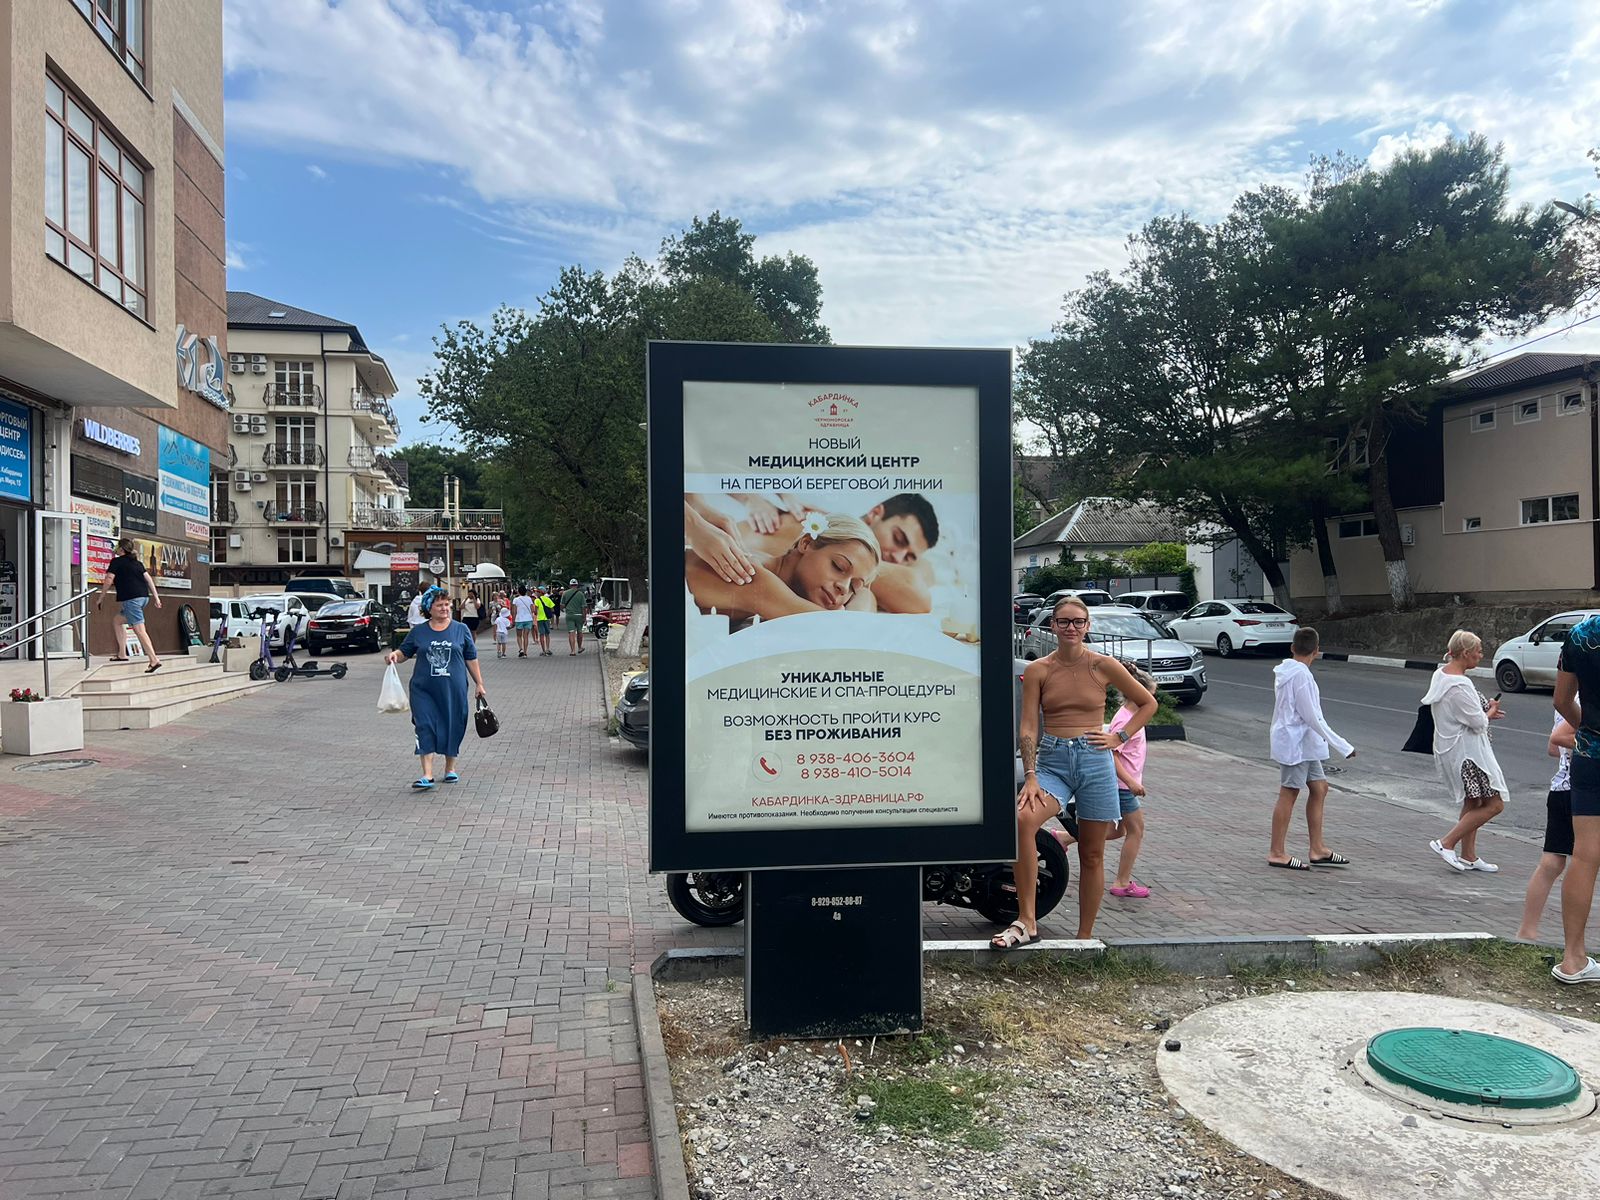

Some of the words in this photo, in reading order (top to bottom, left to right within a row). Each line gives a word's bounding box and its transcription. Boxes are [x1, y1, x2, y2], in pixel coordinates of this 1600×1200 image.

[808, 393, 859, 408] КАБАРДИНКА
[0, 427, 21, 441] ЦЕНТР
[84, 418, 141, 456] WILDBERRIES
[809, 436, 861, 449] НОВЫЙ
[748, 454, 867, 469] МЕДИЦИНСКИЙ
[870, 457, 920, 469] ЦЕНТР
[721, 479, 741, 489] НА
[745, 477, 802, 490] ПЕРВОЙ
[806, 477, 889, 490] БЕРЕГОВОЙ
[893, 478, 943, 490] ЛИНИИ
[125, 488, 155, 510] PODIUM
[186, 522, 208, 535] ПРОДУКТЫ
[161, 544, 187, 567] ДУХИ
[781, 671, 885, 684] УНИКАЛЬНЫЕ
[707, 687, 817, 701] МЕДИЦИНСКИЕ
[821, 686, 831, 698] И
[834, 684, 956, 698] СПА-ПРОЦЕДУРЫ
[723, 713, 839, 727] ВОЗМОЖНОСТЬ
[842, 711, 900, 724] ПРОЙТИ
[903, 711, 941, 723] КУРС
[765, 730, 792, 741] БЕЗ
[796, 727, 901, 740] ПРОЖИВАНИЯ
[797, 754, 805, 765] 8
[810, 751, 915, 764] 938-406-3604
[801, 768, 809, 779] 8
[814, 766, 912, 779] 938-410-5014
[751, 792, 924, 807] КАБАРДИНКА-ЗДРАВНИЦА.РФ
[739, 810, 798, 818] противопоказания.
[841, 808, 874, 816] получение
[875, 807, 917, 815] консультации
[918, 806, 958, 814] специалиста
